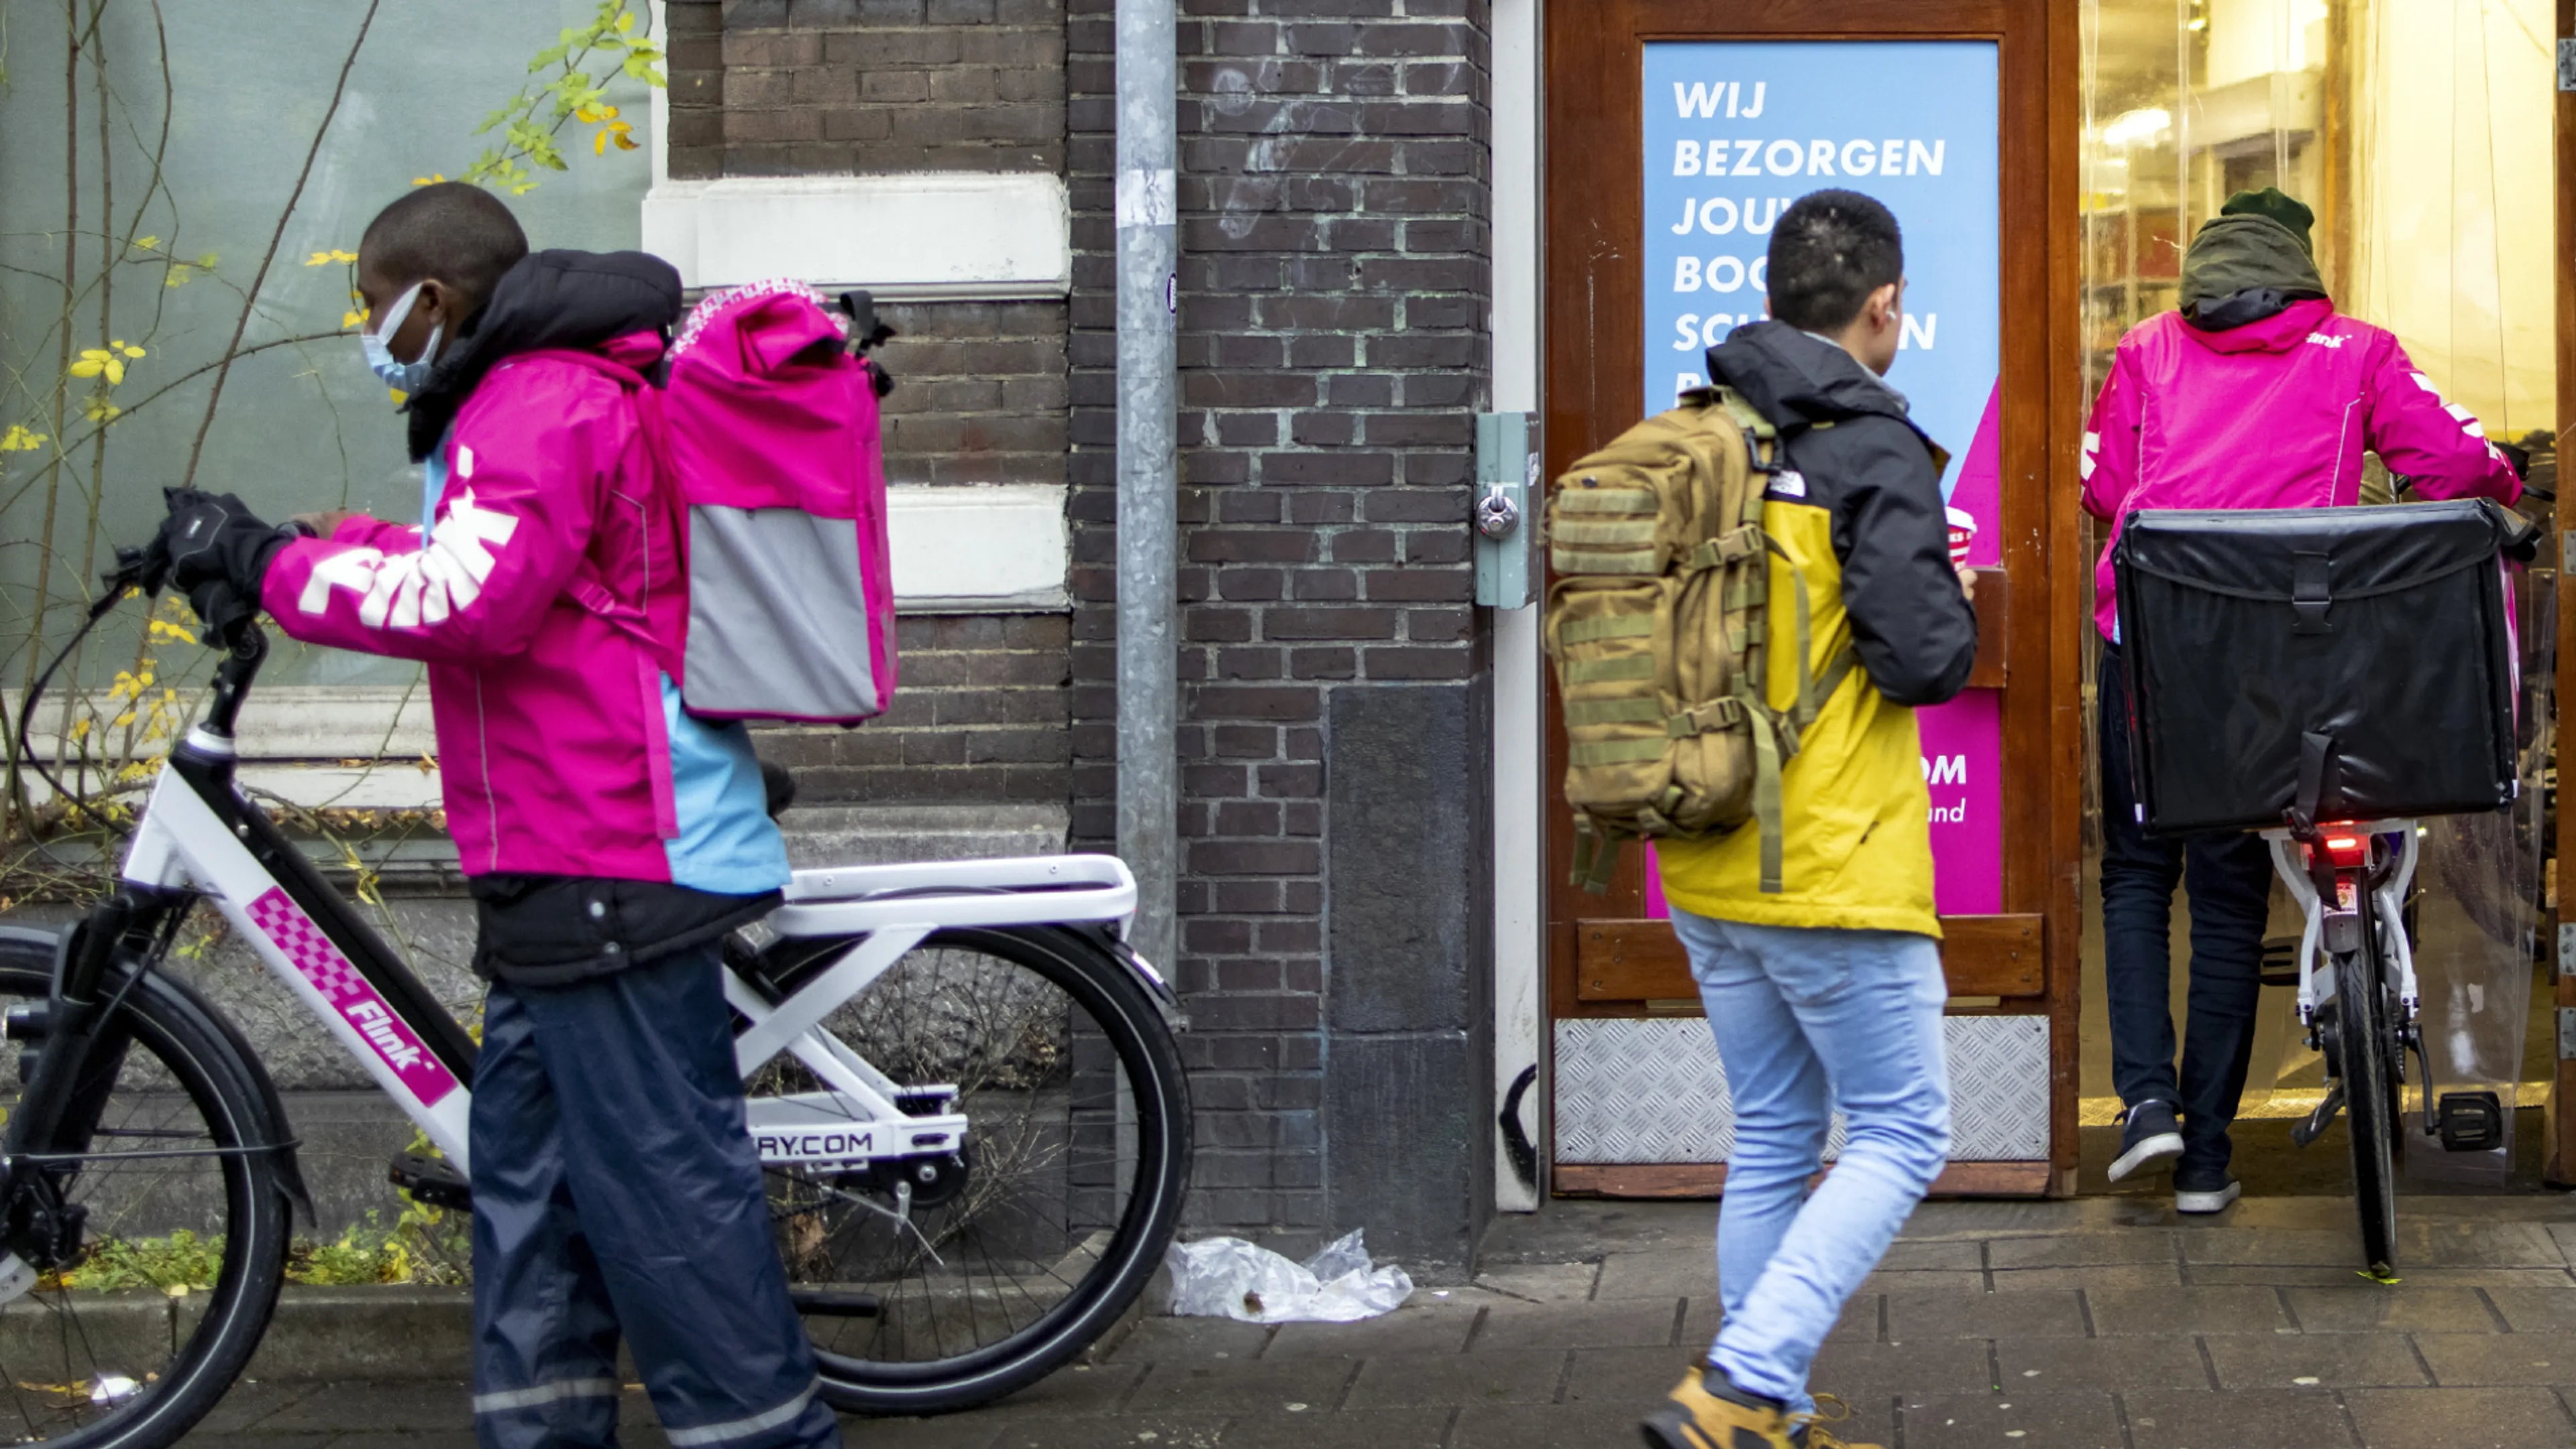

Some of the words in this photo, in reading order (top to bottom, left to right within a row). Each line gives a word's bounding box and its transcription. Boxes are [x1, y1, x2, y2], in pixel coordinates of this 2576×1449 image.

[1673, 81, 1766, 119] WIJ
[1672, 139, 1946, 177] BEZORGEN
[1671, 197, 1793, 236] JOU
[344, 1000, 422, 1071] Flink
[757, 1132, 873, 1157] RY.COM
